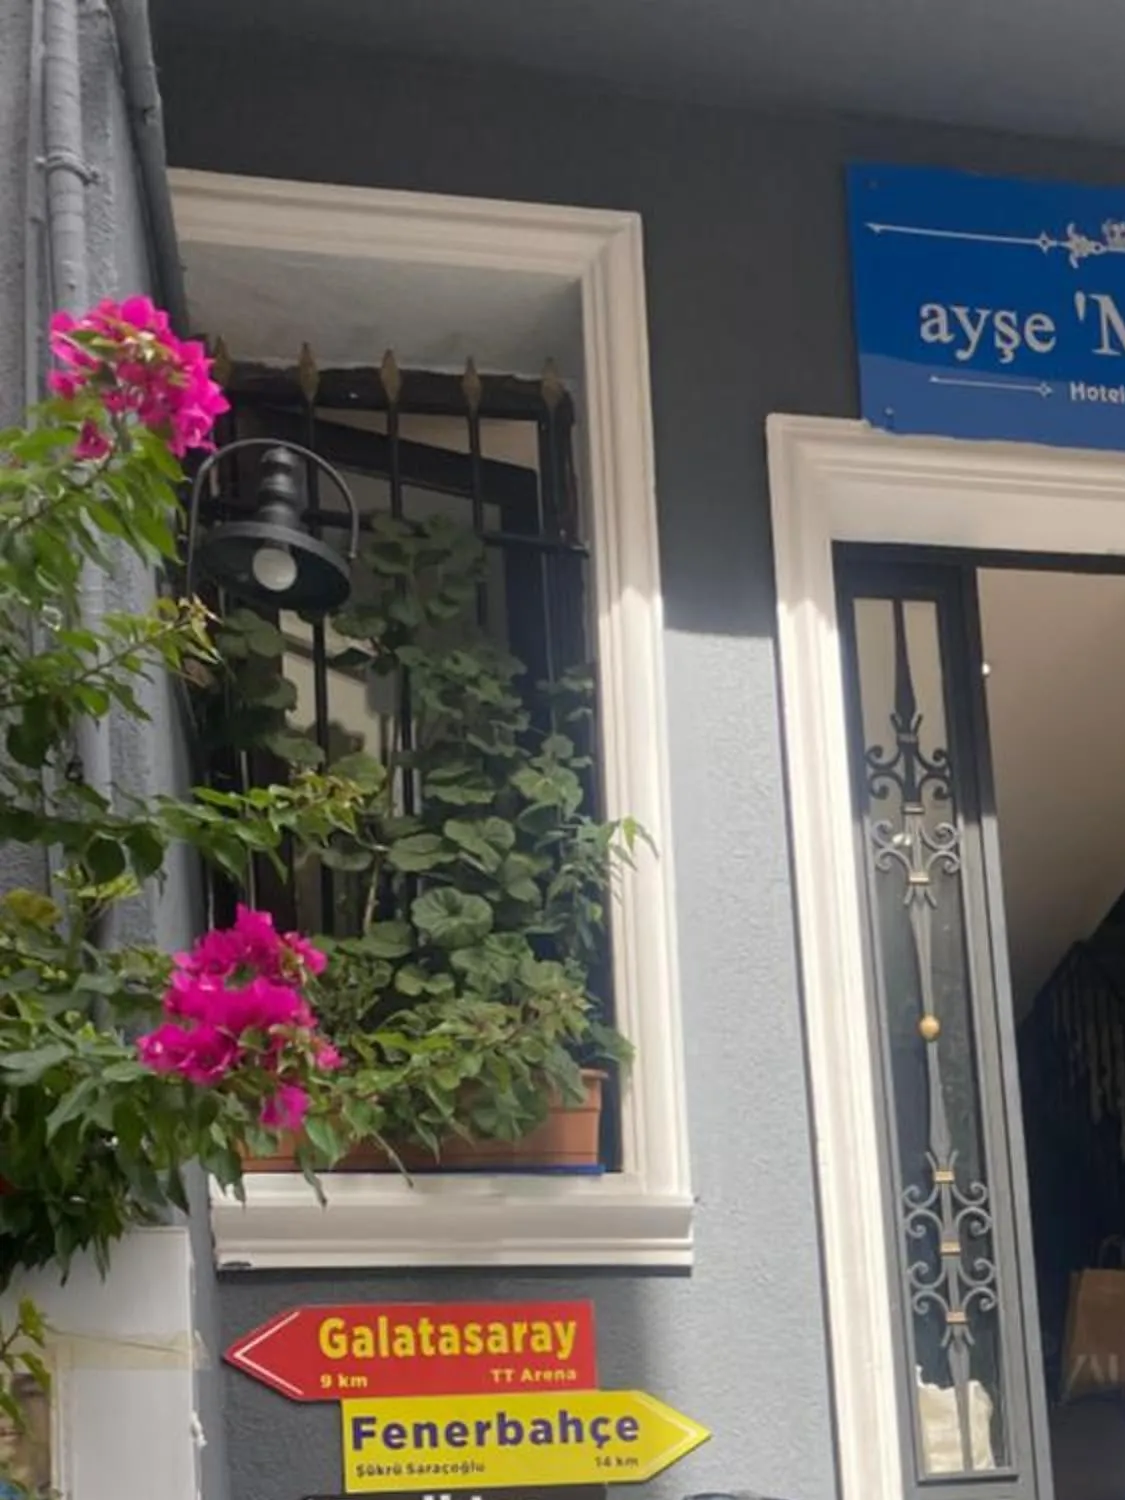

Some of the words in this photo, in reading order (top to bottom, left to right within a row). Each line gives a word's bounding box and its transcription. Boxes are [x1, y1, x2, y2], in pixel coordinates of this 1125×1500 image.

[920, 302, 1055, 363] ayşe
[1069, 381, 1125, 404] Hotel
[319, 1315, 577, 1361] Galatasaray
[320, 1374, 332, 1389] 9
[338, 1372, 368, 1388] km
[491, 1368, 515, 1383] TT
[520, 1366, 577, 1382] Arena
[351, 1411, 640, 1451] Fenerbahçe
[615, 1456, 639, 1468] km
